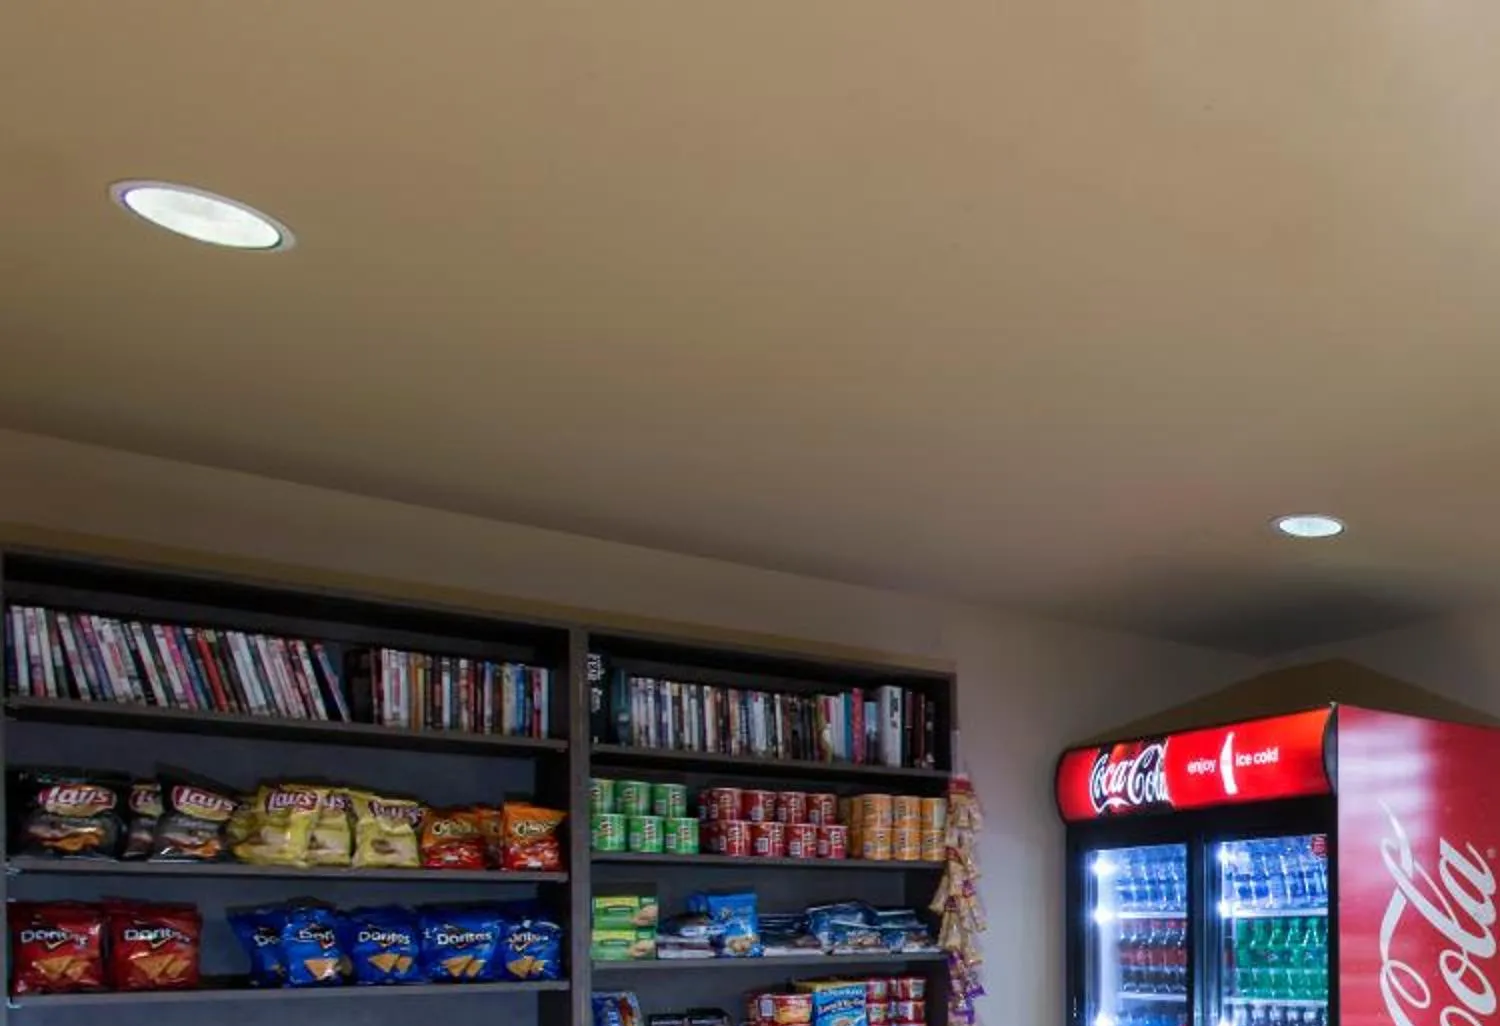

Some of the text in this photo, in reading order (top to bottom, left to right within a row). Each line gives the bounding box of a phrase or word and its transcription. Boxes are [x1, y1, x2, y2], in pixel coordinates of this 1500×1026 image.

[1187, 757, 1216, 775] enjoy
[1235, 747, 1279, 767] ice cold
[436, 930, 493, 946] Doritos
